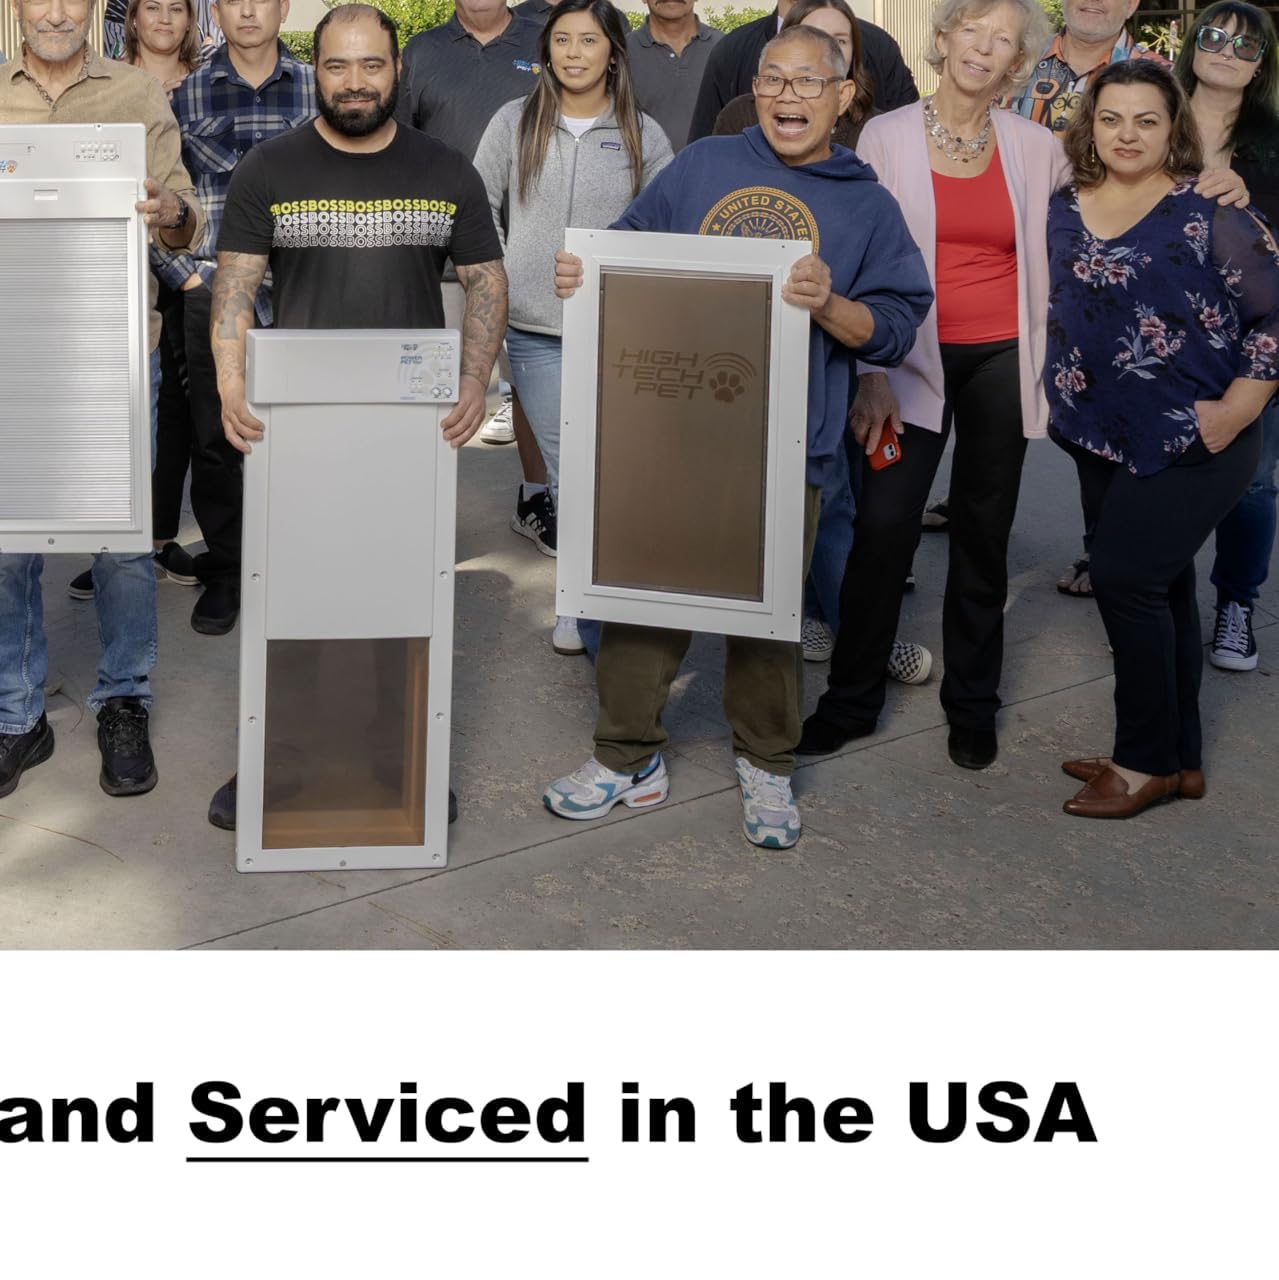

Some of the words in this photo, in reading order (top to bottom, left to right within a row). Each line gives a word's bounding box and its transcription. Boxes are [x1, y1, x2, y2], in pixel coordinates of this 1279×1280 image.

[719, 195, 770, 219] UNITED
[619, 348, 699, 368] HIGH
[611, 363, 705, 382] TECH
[634, 381, 704, 400] PET
